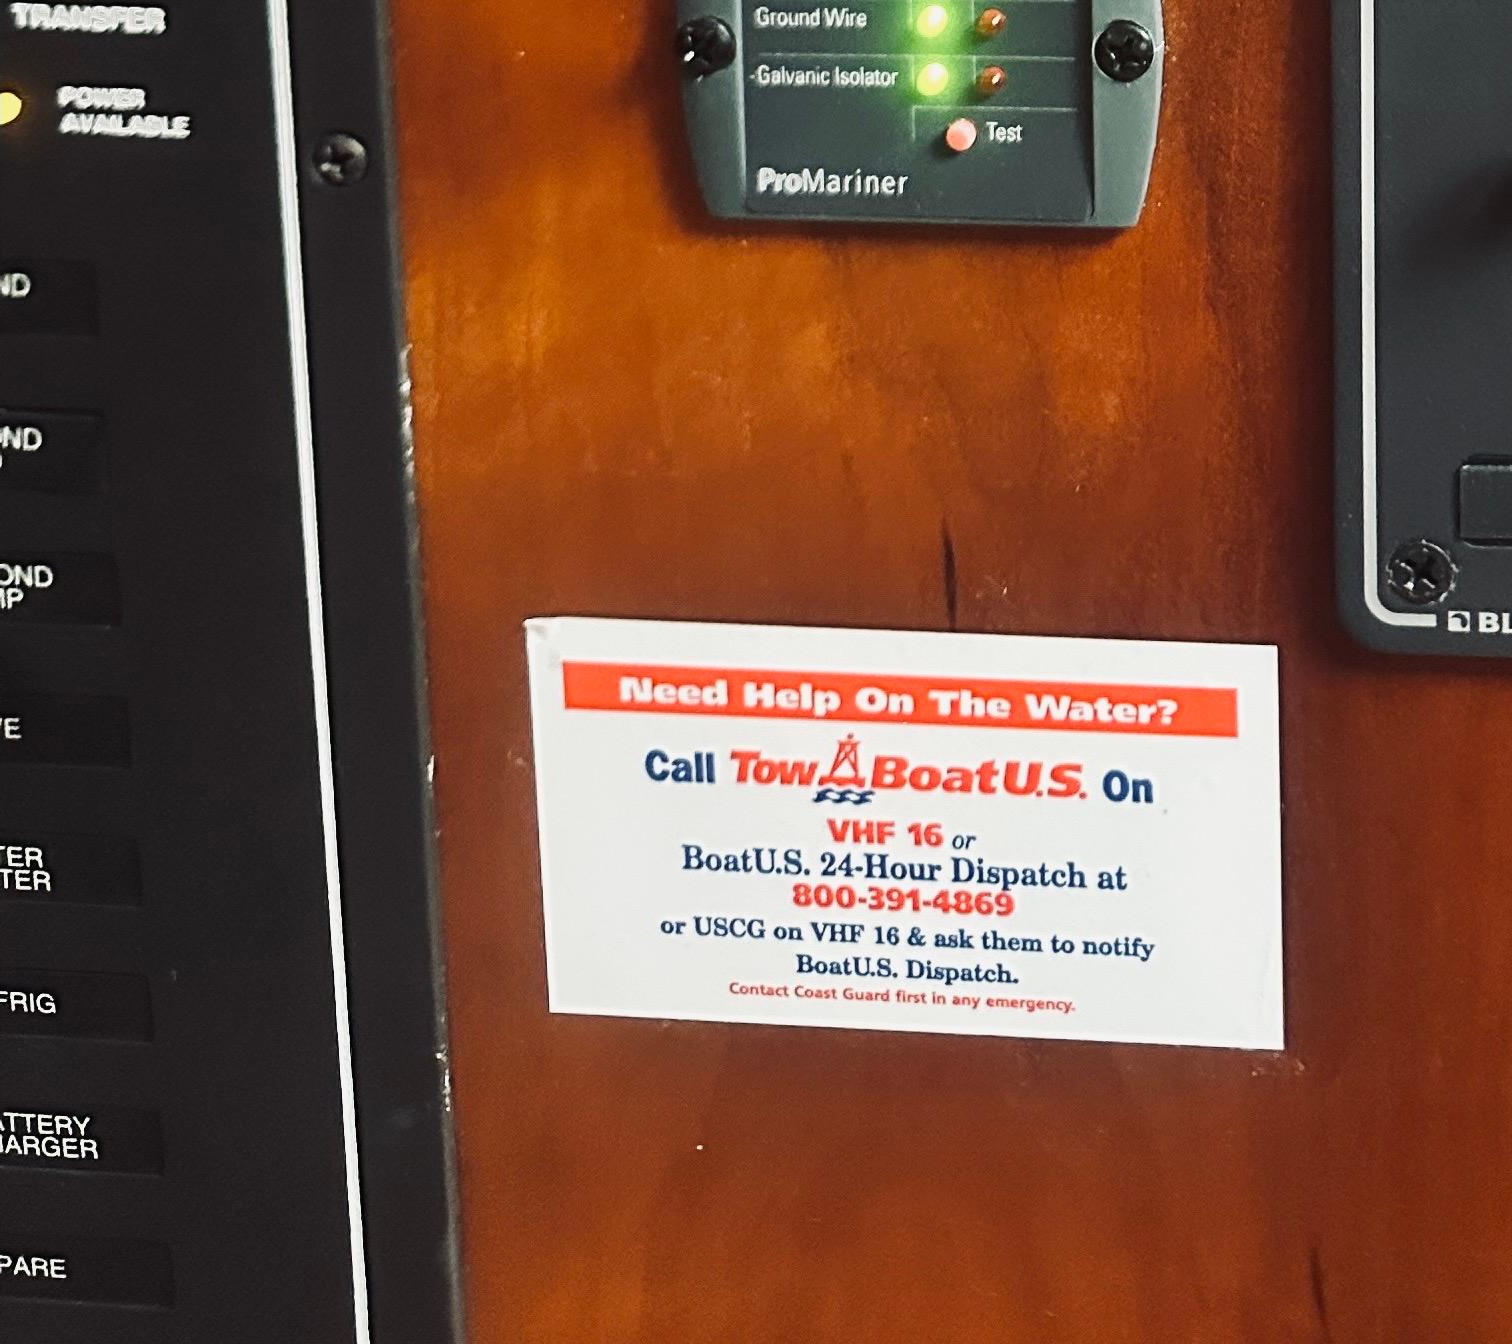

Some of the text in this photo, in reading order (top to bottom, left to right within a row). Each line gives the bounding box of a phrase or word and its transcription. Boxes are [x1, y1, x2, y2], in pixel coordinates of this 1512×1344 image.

[10, 3, 166, 34] TRANSFER
[755, 9, 867, 28] Ground Wire
[756, 67, 898, 87] Galvanic Isolator
[56, 86, 146, 110] POWER
[58, 113, 191, 139] AVAILABLE
[987, 123, 1023, 142] Test
[756, 168, 908, 195] ProMariner
[619, 677, 1179, 725] Need Help On The Water?
[644, 750, 715, 785] Call
[1102, 771, 1154, 804] On
[828, 819, 976, 850] VHF 16 or
[681, 844, 1127, 892] BoatU.S. 24-Hour Dispatch at
[793, 884, 1015, 917] 800-391-4869
[660, 916, 1156, 962] or USCG on VHF 16 & ask them to notify
[796, 955, 1020, 985] BoatU.S. Dispatch.
[729, 982, 1076, 1013] Contact Coast Guard first in any emergency.
